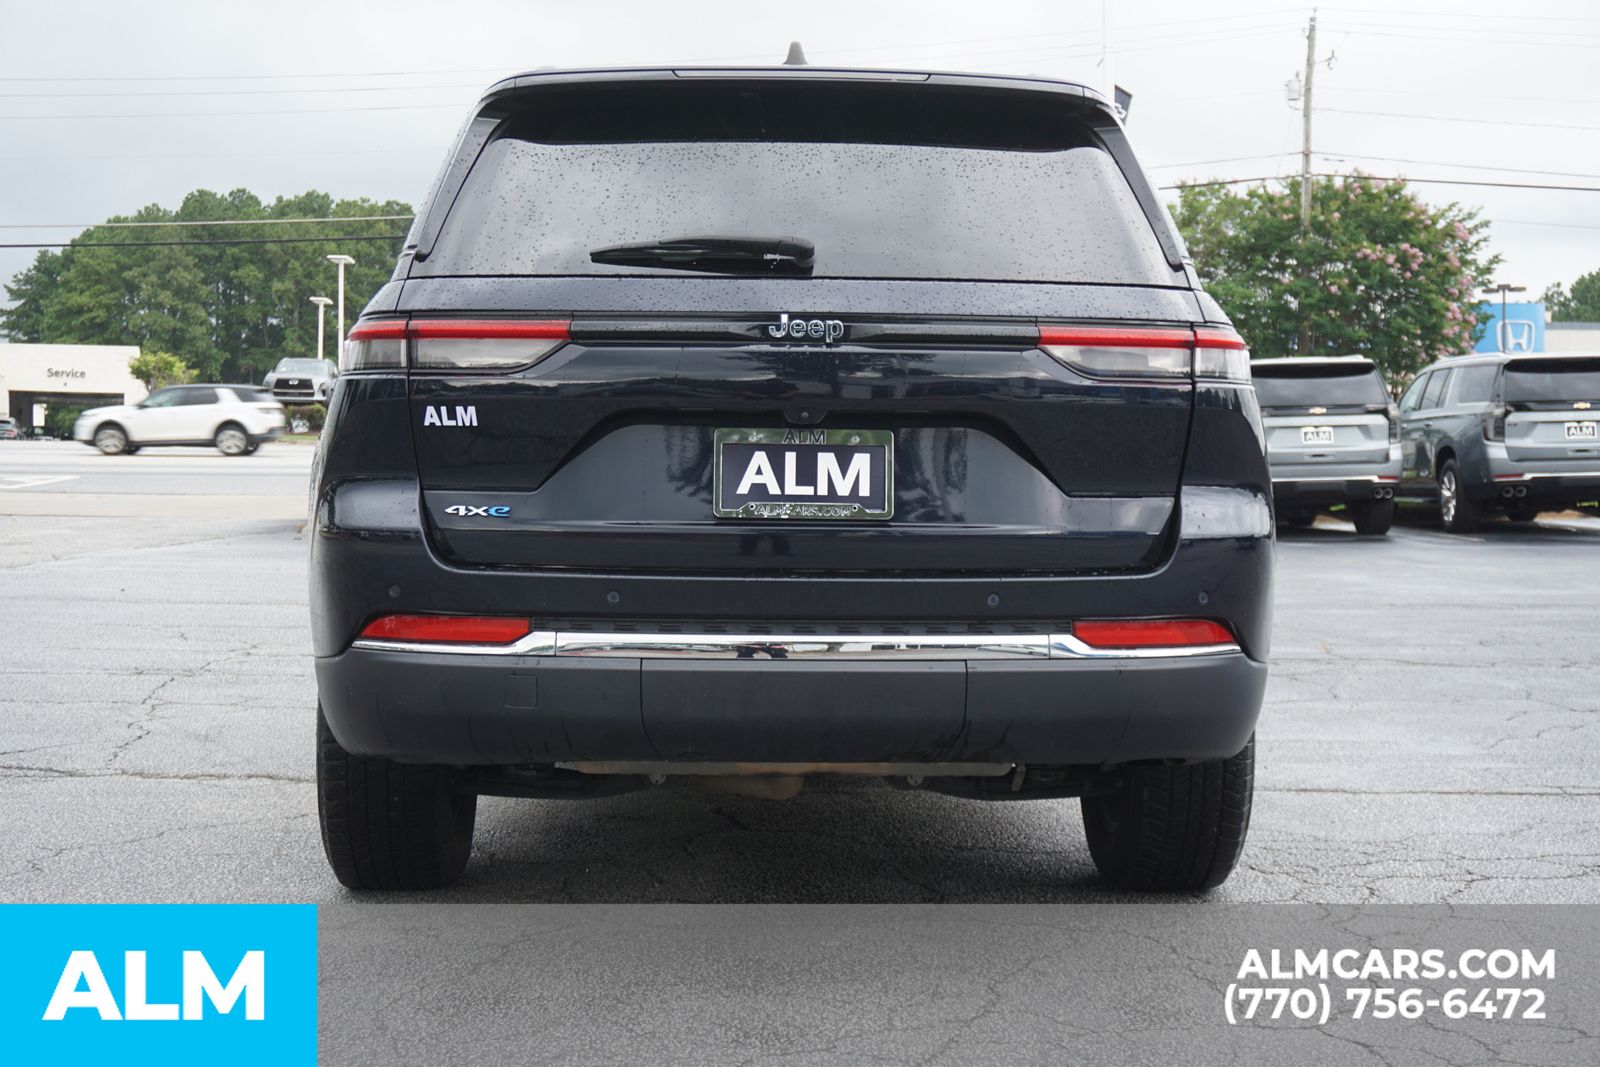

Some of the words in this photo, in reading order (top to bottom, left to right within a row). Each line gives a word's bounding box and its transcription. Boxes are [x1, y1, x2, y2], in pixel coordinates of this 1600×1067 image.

[768, 313, 844, 343] Jeep
[47, 367, 86, 378] Service
[423, 405, 478, 427] ALM
[783, 429, 827, 445] ALM
[1306, 431, 1330, 441] ALM
[1569, 426, 1593, 437] ALM
[736, 450, 871, 497] ALM
